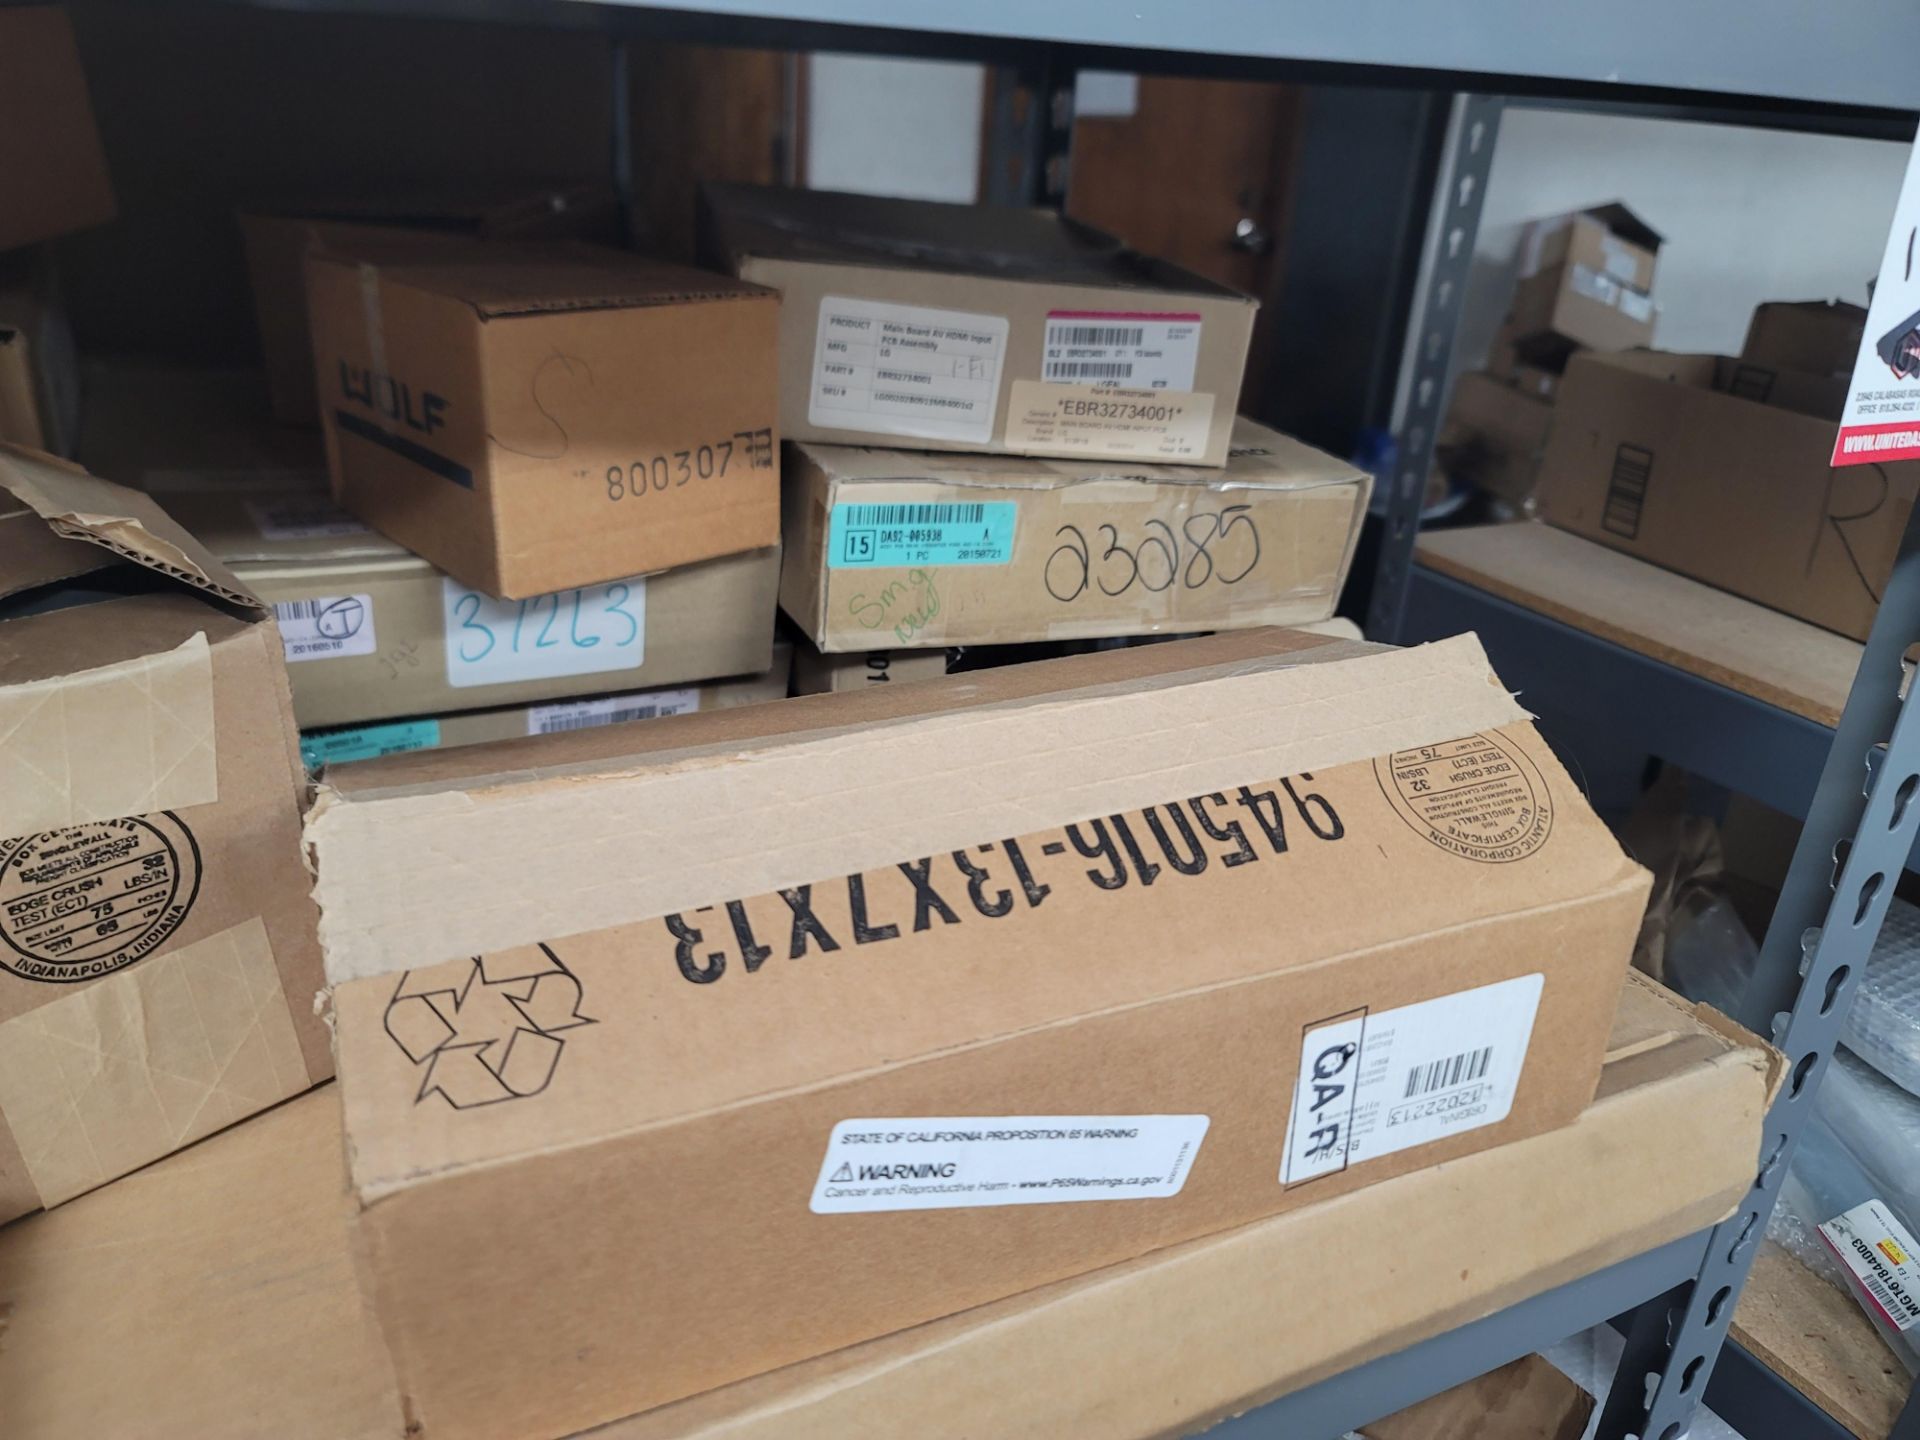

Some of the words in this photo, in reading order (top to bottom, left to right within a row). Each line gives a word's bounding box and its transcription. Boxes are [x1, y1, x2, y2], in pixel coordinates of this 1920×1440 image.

[830, 317, 871, 330] PRODUCT
[884, 324, 903, 333] Main
[906, 327, 932, 337] Board
[971, 334, 993, 344] Input
[827, 343, 848, 352] MFG
[881, 336, 898, 345] PCB
[899, 338, 938, 352] Assembly
[824, 364, 847, 375] PART
[983, 528, 989, 541] A
[849, 536, 869, 555] 15
[906, 551, 911, 560] 1
[916, 551, 929, 560] PC
[957, 550, 1001, 560] 20150721
[1421, 748, 1442, 759] 75
[1479, 752, 1504, 763] TEST
[1452, 756, 1478, 769] (ECT)
[1483, 763, 1511, 775] EDGE
[1396, 767, 1429, 780] LBS/IN
[1449, 769, 1483, 783] CRUSH
[1410, 779, 1431, 791] 32
[1481, 782, 1508, 791] FREIGHT
[1429, 788, 1480, 802] CLASSIFICATION
[1477, 787, 1523, 802] REQUIREMENTS
[1493, 798, 1513, 806] MEETS
[1424, 801, 1463, 813] APPLICABLE
[1429, 806, 1478, 820] CONSTRUCTION
[1453, 807, 1515, 826] SINGLEWALL
[1481, 820, 1498, 829] THIS
[1517, 807, 1531, 828] BOX
[1448, 825, 1519, 844] CERTIFICATE
[1521, 805, 1548, 850] ATLANTIC
[40, 831, 112, 860] SINGLEWALL
[1429, 831, 1521, 859] CORPORATION
[12, 845, 38, 867] BOX
[8, 895, 49, 916] EDGE
[52, 877, 103, 902] CRUSH
[12, 908, 48, 928] TEST
[52, 896, 88, 918] (ECT)
[124, 868, 168, 889] LBS/IN
[91, 902, 114, 919] 75
[15, 953, 134, 978] INDIANAPOLIS,
[134, 904, 185, 953] INDIANA
[1304, 1041, 1357, 1159] QA-R
[1390, 1087, 1482, 1127] 12022213
[1440, 1103, 1487, 1125] ORIGINAL
[841, 1133, 885, 1144] STATE
[886, 1132, 904, 1143] OF
[907, 1131, 982, 1143] CALIFORNIA
[985, 1130, 1066, 1142] PROPOSITION
[1069, 1129, 1082, 1139] 65
[1084, 1128, 1139, 1139] WARNING
[859, 1163, 956, 1180] WARNING
[824, 1186, 869, 1198] Cancer
[872, 1185, 896, 1196] and
[898, 1182, 975, 1197] Reproductive
[978, 1181, 1009, 1191] Harm
[1019, 1176, 1163, 1189] www.P65Warnings.ca.gov
[1852, 1238, 1920, 1316] MGT61844003
